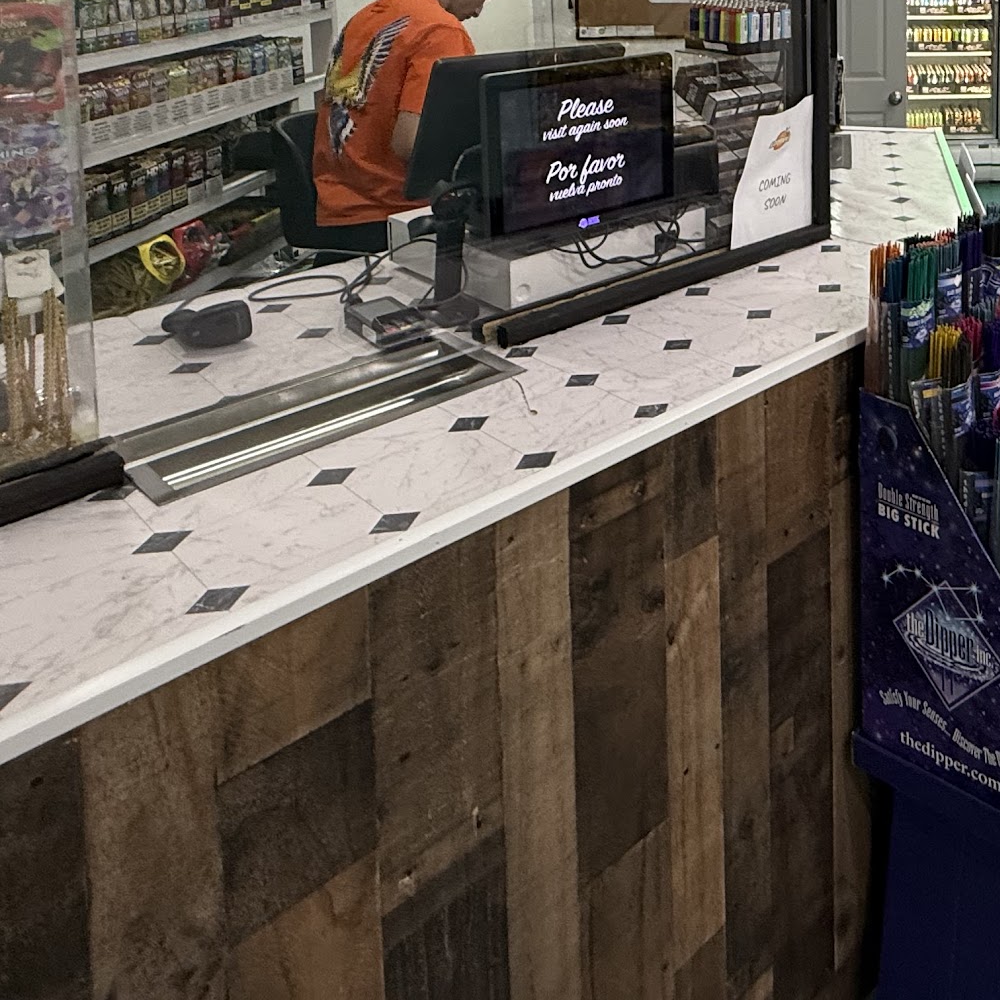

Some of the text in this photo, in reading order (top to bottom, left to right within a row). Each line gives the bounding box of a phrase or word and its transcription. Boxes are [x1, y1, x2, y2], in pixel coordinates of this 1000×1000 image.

[557, 97, 615, 121] Please
[542, 116, 629, 142] visit again soon
[545, 152, 626, 184] Por favor
[758, 172, 792, 192] COMING
[548, 173, 623, 202] vuelva pronto
[764, 195, 788, 211] SOON
[877, 482, 903, 507] Double
[904, 493, 939, 521] Strength
[878, 502, 940, 540] BIG STICK
[906, 612, 925, 638] the
[925, 608, 974, 662] Dipper
[903, 690, 921, 711] Your
[952, 728, 982, 760] Discover
[983, 746, 997, 766] The
